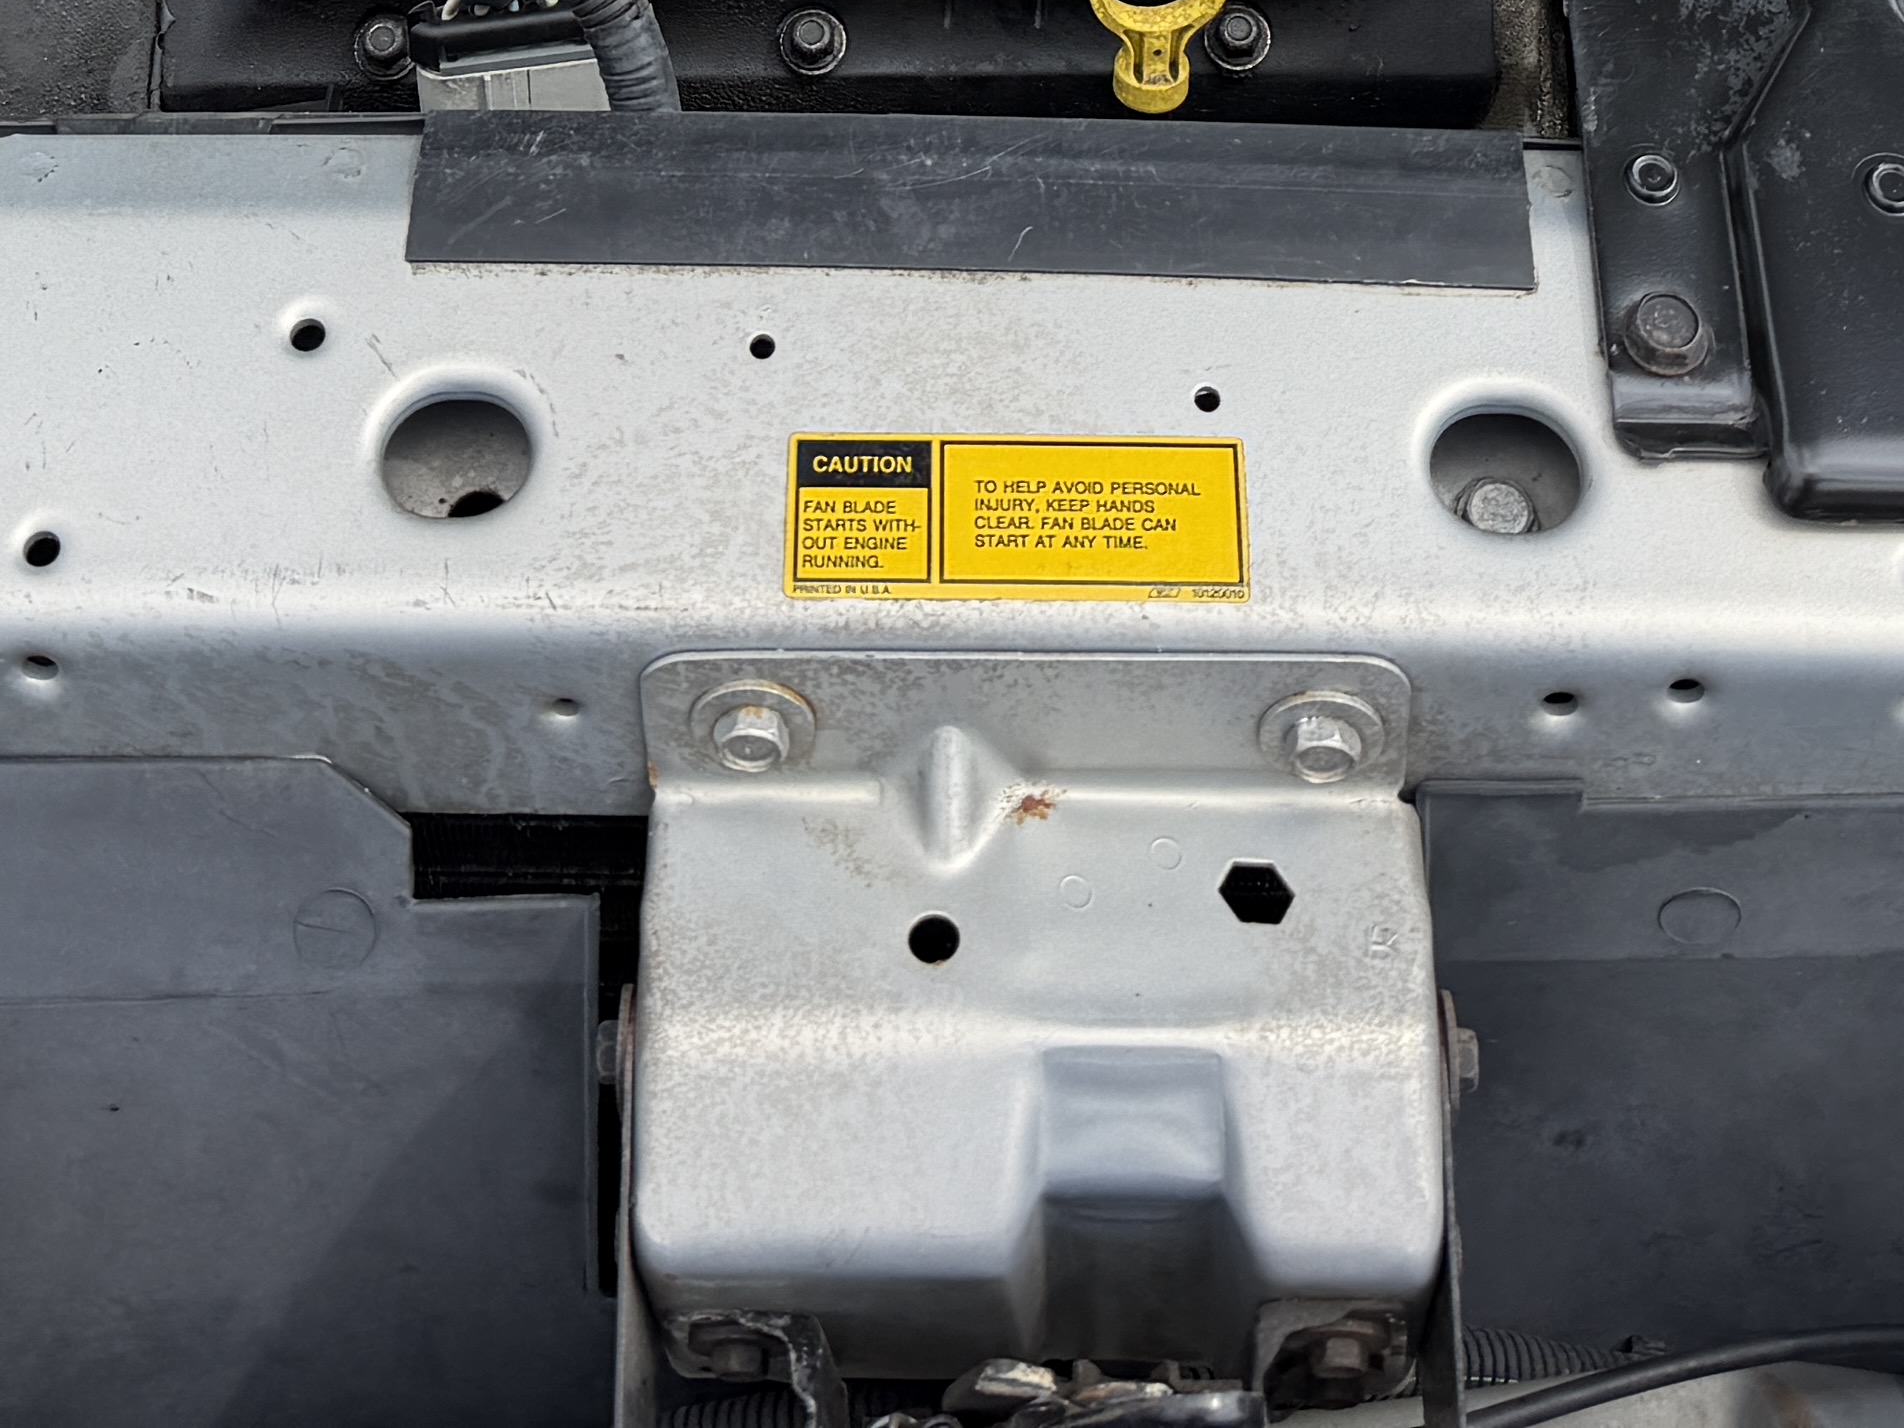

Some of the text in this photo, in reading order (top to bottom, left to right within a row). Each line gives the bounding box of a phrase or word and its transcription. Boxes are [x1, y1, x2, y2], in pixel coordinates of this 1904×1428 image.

[812, 455, 913, 473] CAUTION
[974, 480, 1201, 496] TO HELP AVOID PERSONAL
[803, 500, 897, 514] FAN BLADE
[974, 498, 1155, 514] INJURY, KEEP HANDS
[803, 518, 922, 532] STARTS WITH-
[974, 516, 1177, 532] CLEAR. FAN BLADE CAN
[802, 536, 908, 550] OUT ENGINE
[974, 534, 1148, 550] START AT ANY TIME.
[802, 554, 884, 569] RUNNING.
[793, 584, 842, 594] PRINTED
